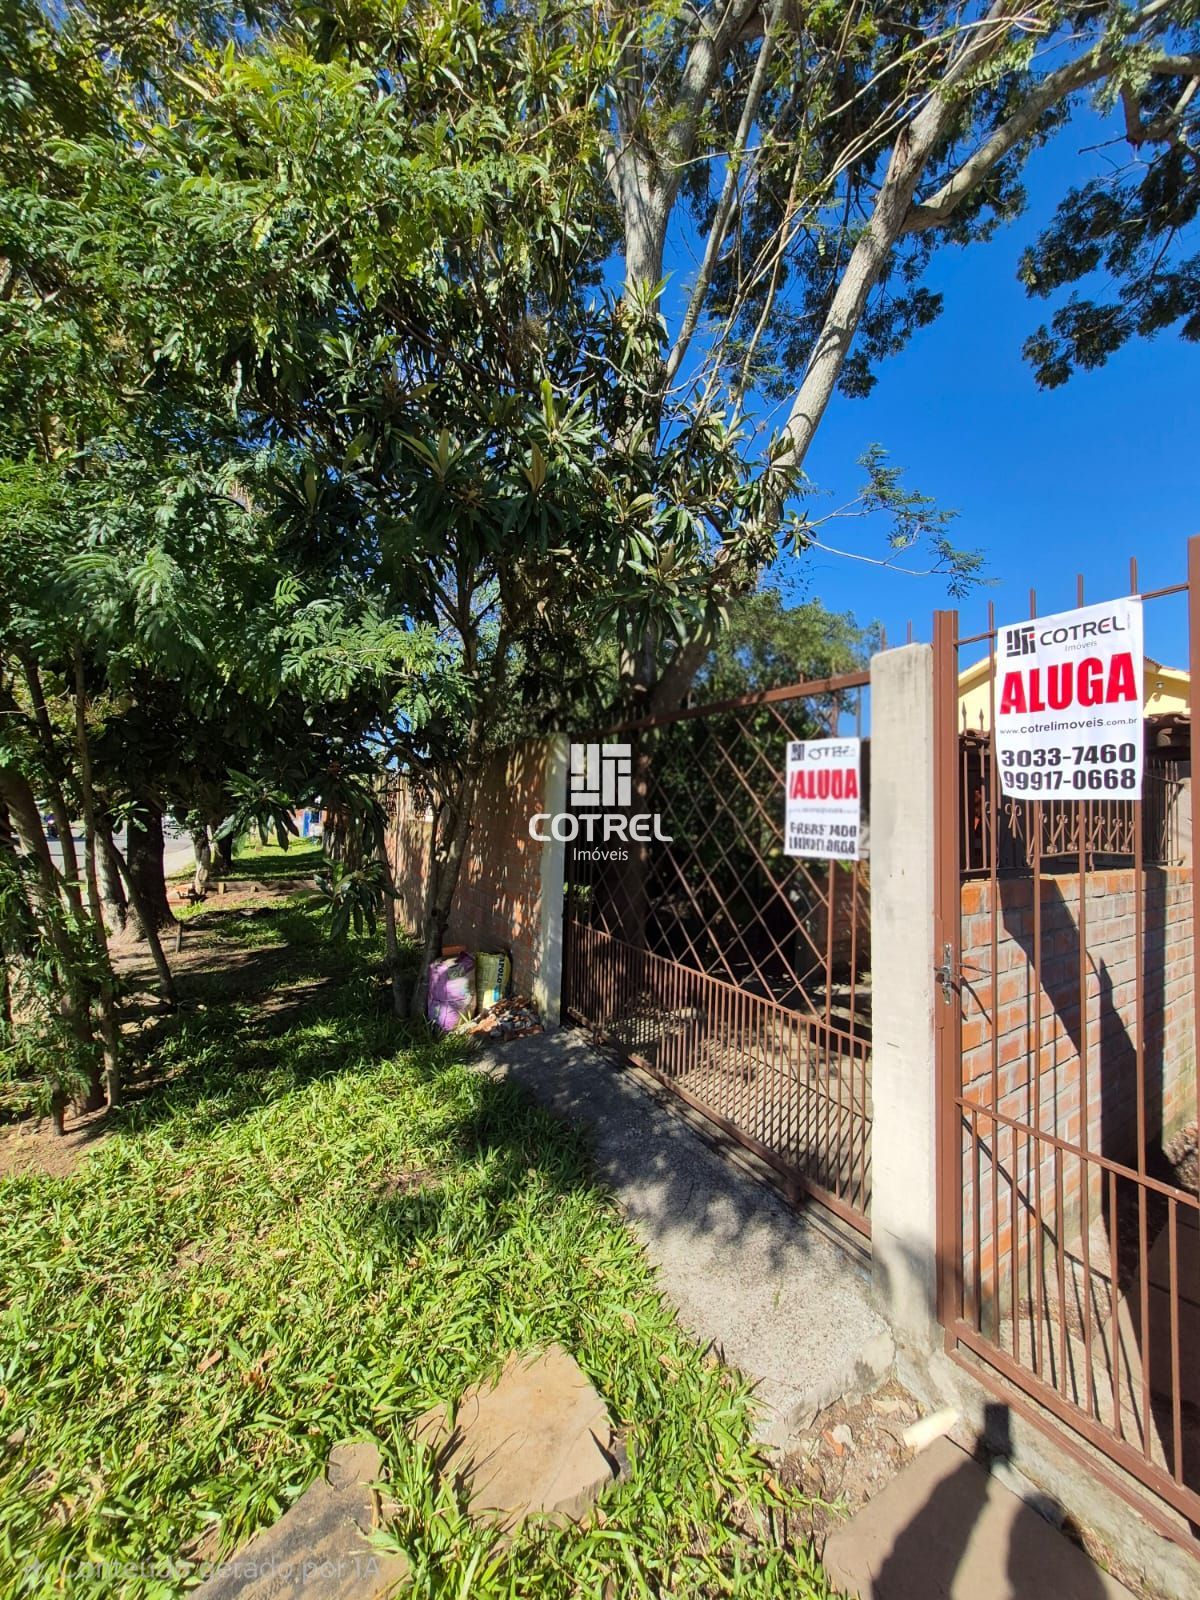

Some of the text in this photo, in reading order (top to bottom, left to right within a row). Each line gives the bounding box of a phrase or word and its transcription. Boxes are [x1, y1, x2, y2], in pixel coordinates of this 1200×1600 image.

[1039, 615, 1125, 646] COTREL
[1064, 640, 1098, 652] Imóveis
[1000, 652, 1137, 715] ALUGA
[999, 717, 1137, 735] www.cotrelimoveis.com.br
[1001, 743, 1136, 767] 3033-7460
[1003, 768, 1136, 790] 99917-0668
